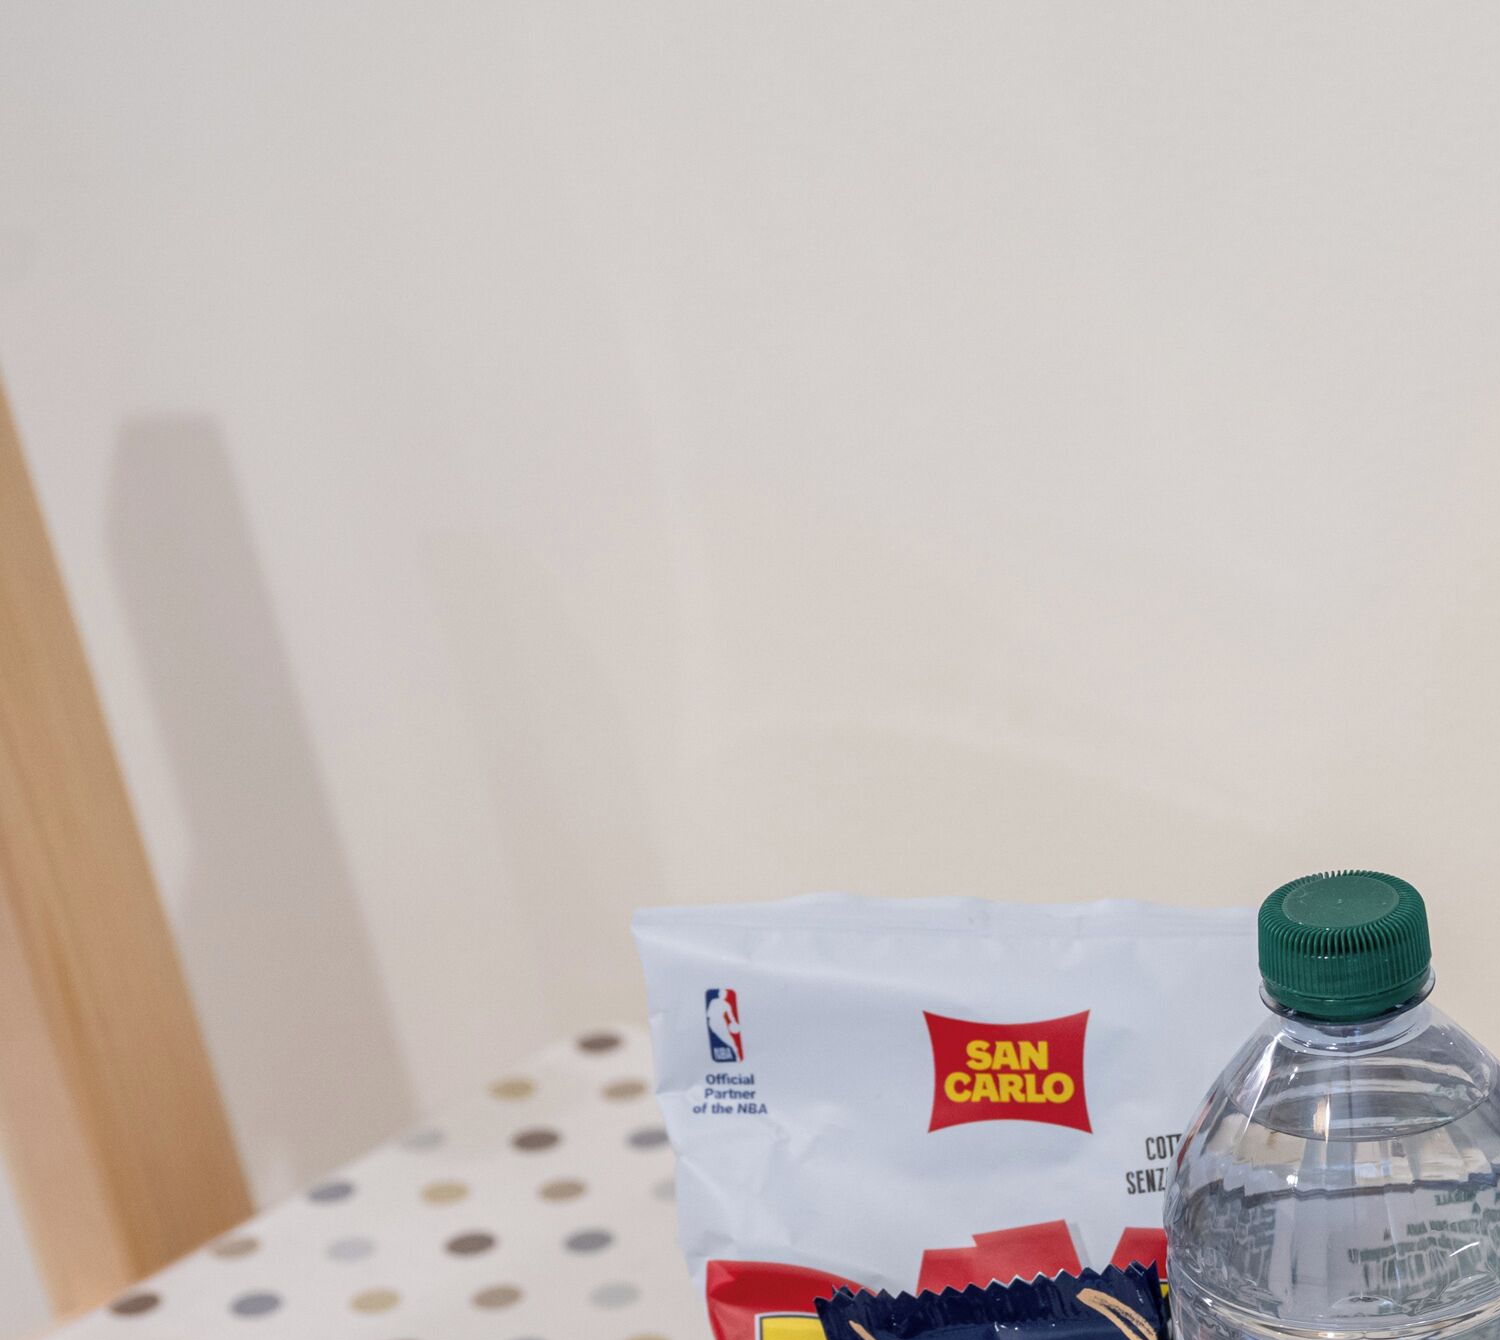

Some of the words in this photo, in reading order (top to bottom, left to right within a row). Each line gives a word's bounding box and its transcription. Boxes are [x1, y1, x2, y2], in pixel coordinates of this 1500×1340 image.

[966, 1040, 1049, 1071] SAN
[705, 1073, 755, 1085] Official
[944, 1072, 1074, 1104] CARLO
[704, 1088, 756, 1100] Partner
[692, 1103, 707, 1114] of
[711, 1103, 733, 1114] the
[737, 1103, 768, 1115] NBA
[1126, 1167, 1168, 1195] SENZ
